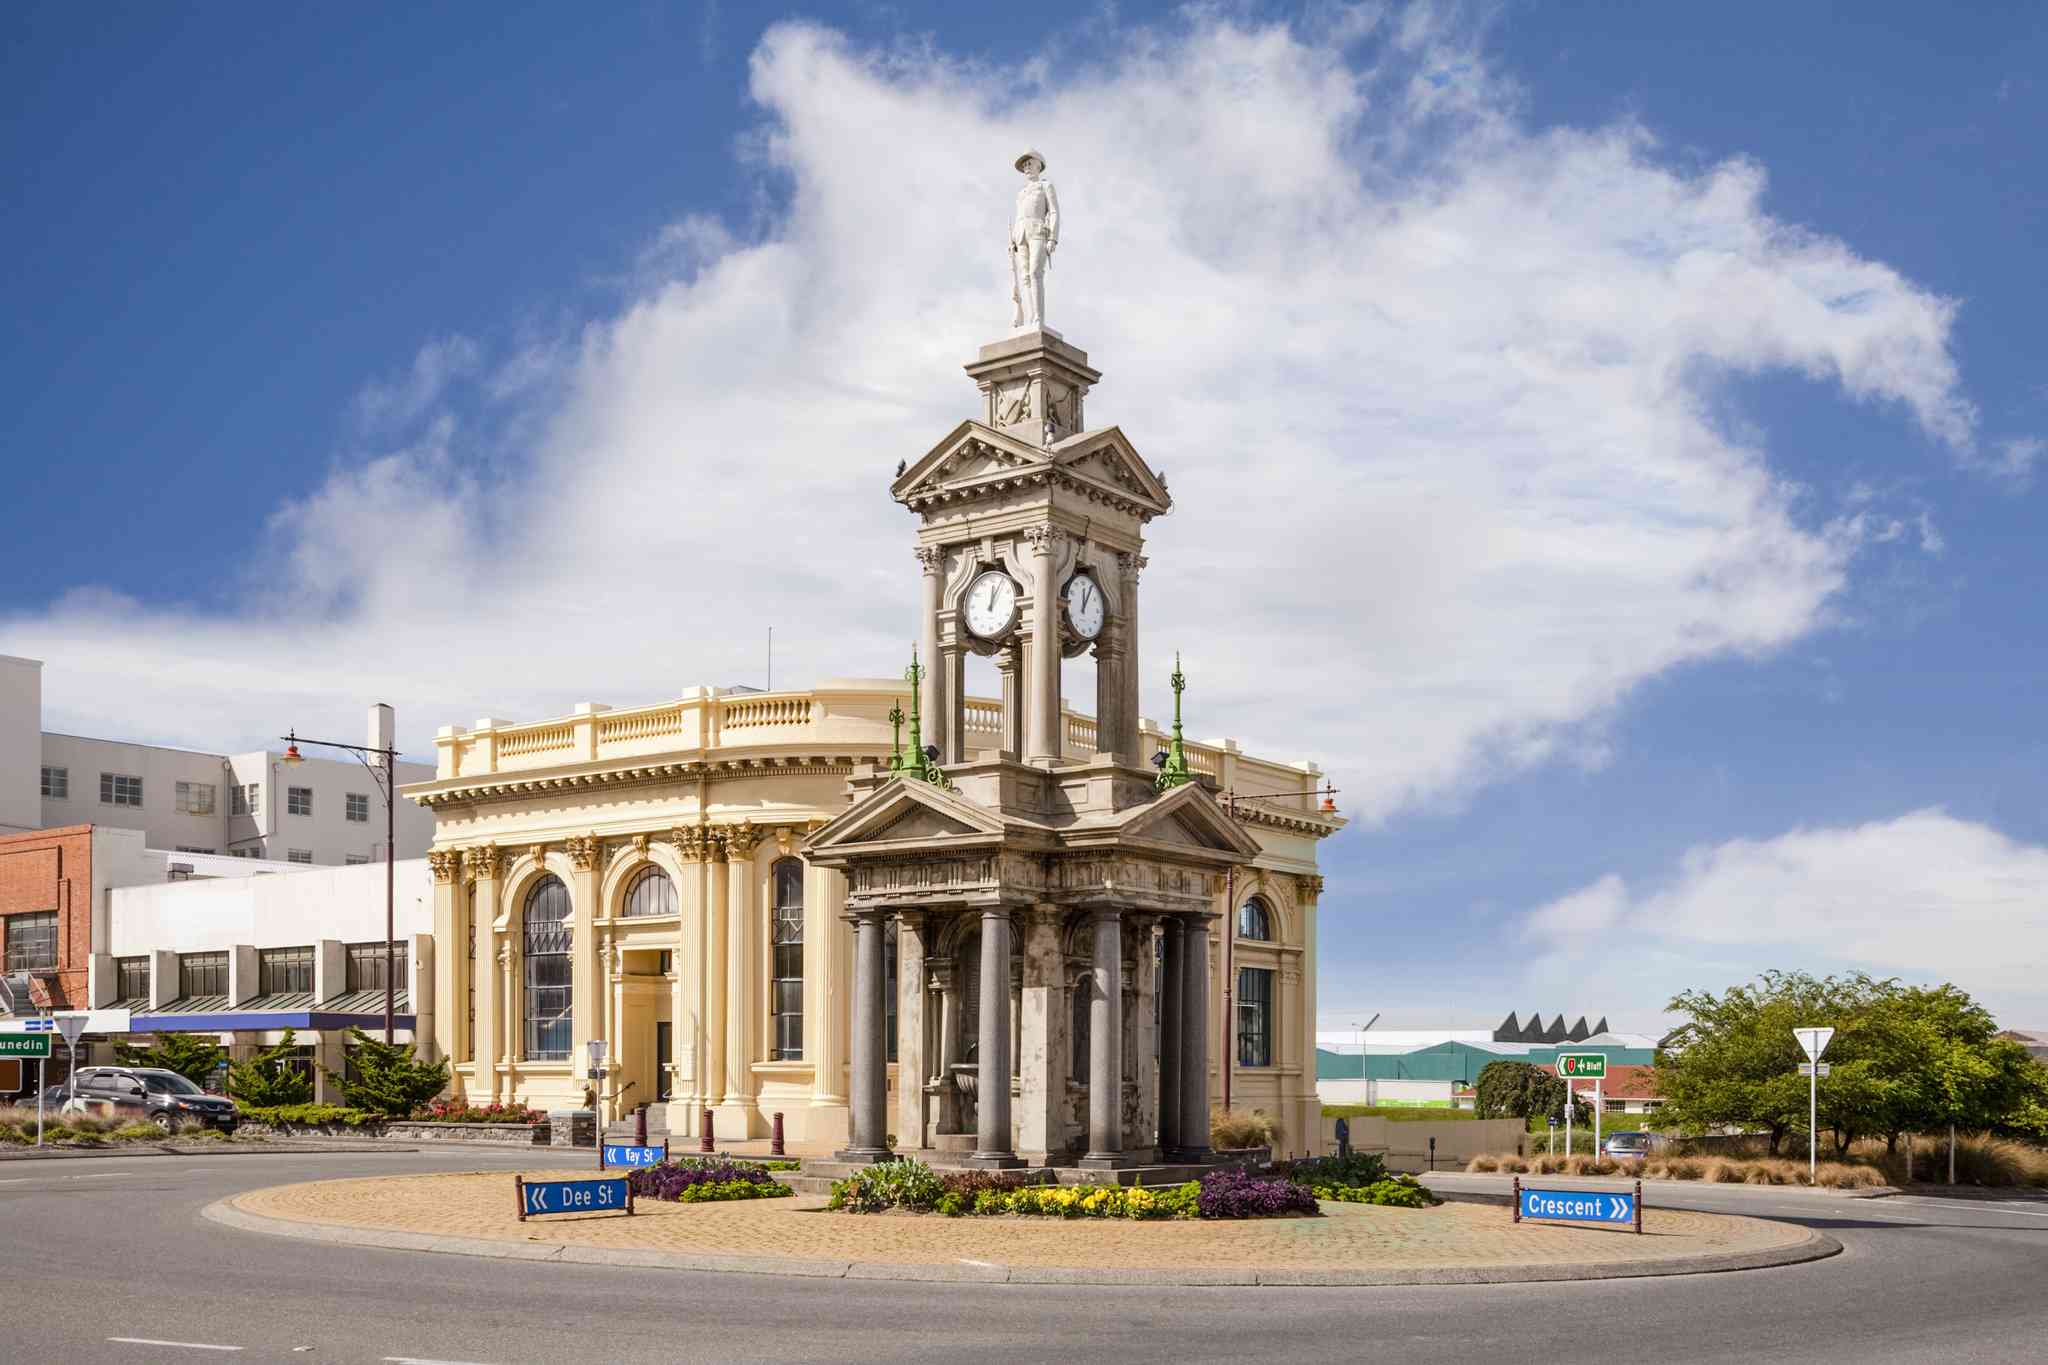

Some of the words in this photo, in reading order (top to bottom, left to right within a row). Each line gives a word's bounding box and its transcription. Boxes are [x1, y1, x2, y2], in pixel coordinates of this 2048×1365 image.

[0, 1040, 43, 1050] unedin
[626, 1148, 640, 1166] Tay
[644, 1149, 654, 1162] St
[562, 1187, 591, 1206] Dee
[598, 1185, 613, 1204] St
[1529, 1195, 1602, 1216] Crescent
